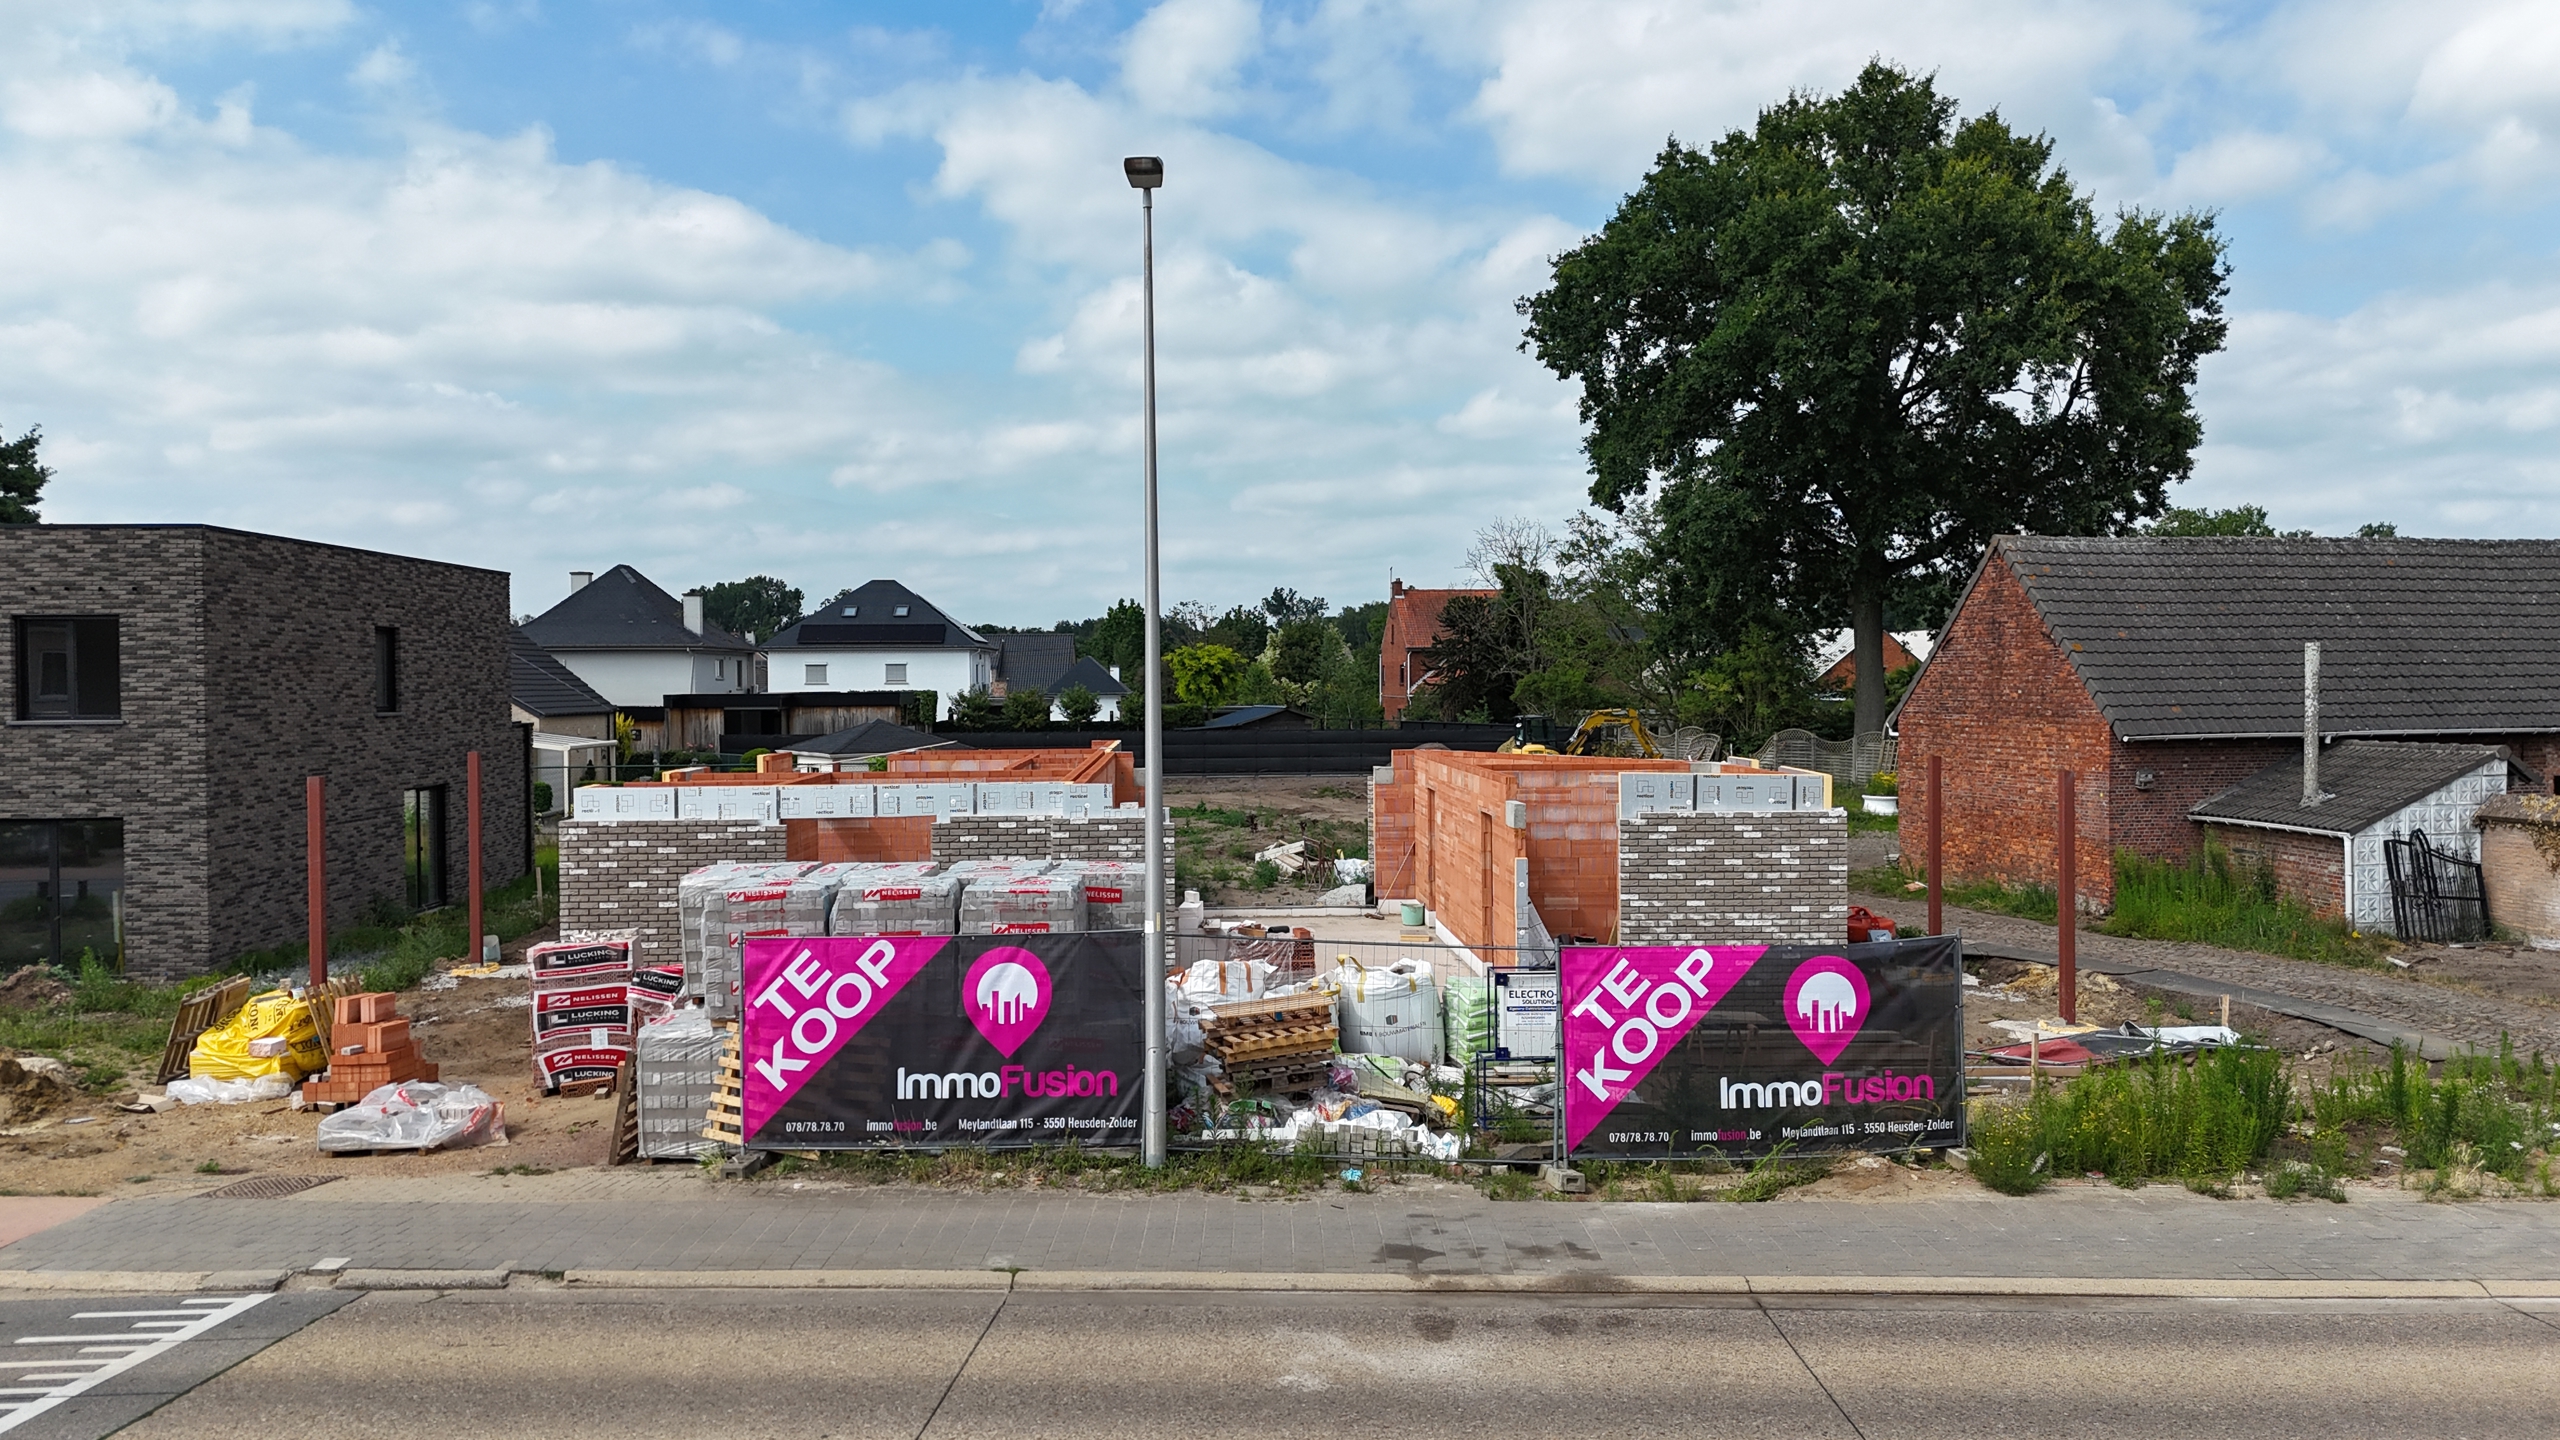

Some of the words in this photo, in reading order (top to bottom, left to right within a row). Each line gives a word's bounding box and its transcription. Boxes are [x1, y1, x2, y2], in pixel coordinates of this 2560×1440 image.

[1086, 891, 1120, 899] NELISSEN
[567, 950, 618, 960] LUCKING
[642, 974, 679, 987] LUCKING
[753, 948, 833, 1020] TE
[572, 993, 619, 1002] NELISSEN
[1571, 957, 1652, 1029] TE
[571, 1010, 620, 1019] LUCKING
[754, 939, 896, 1092] KOOP
[1576, 948, 1714, 1103] KOOP
[897, 1064, 1118, 1100] ImmoFusion
[1720, 1069, 1934, 1109] ImmoFusion
[785, 1121, 845, 1132] 078/78.78.70
[866, 1119, 938, 1131] immofusion.be
[958, 1118, 1018, 1132] Meylandtlaan
[1020, 1118, 1034, 1129] 115
[1043, 1117, 1065, 1129] 3550
[1068, 1117, 1138, 1129] Heusden-Zolder
[1609, 1132, 1669, 1143] 078/78.78.70
[1691, 1128, 1762, 1142] immofusion.be
[1782, 1125, 1839, 1140] Meylandtlaan
[1841, 1124, 1854, 1135] 115
[1864, 1122, 1886, 1134] 3550
[1887, 1119, 1954, 1132] Heusden-Zolder
